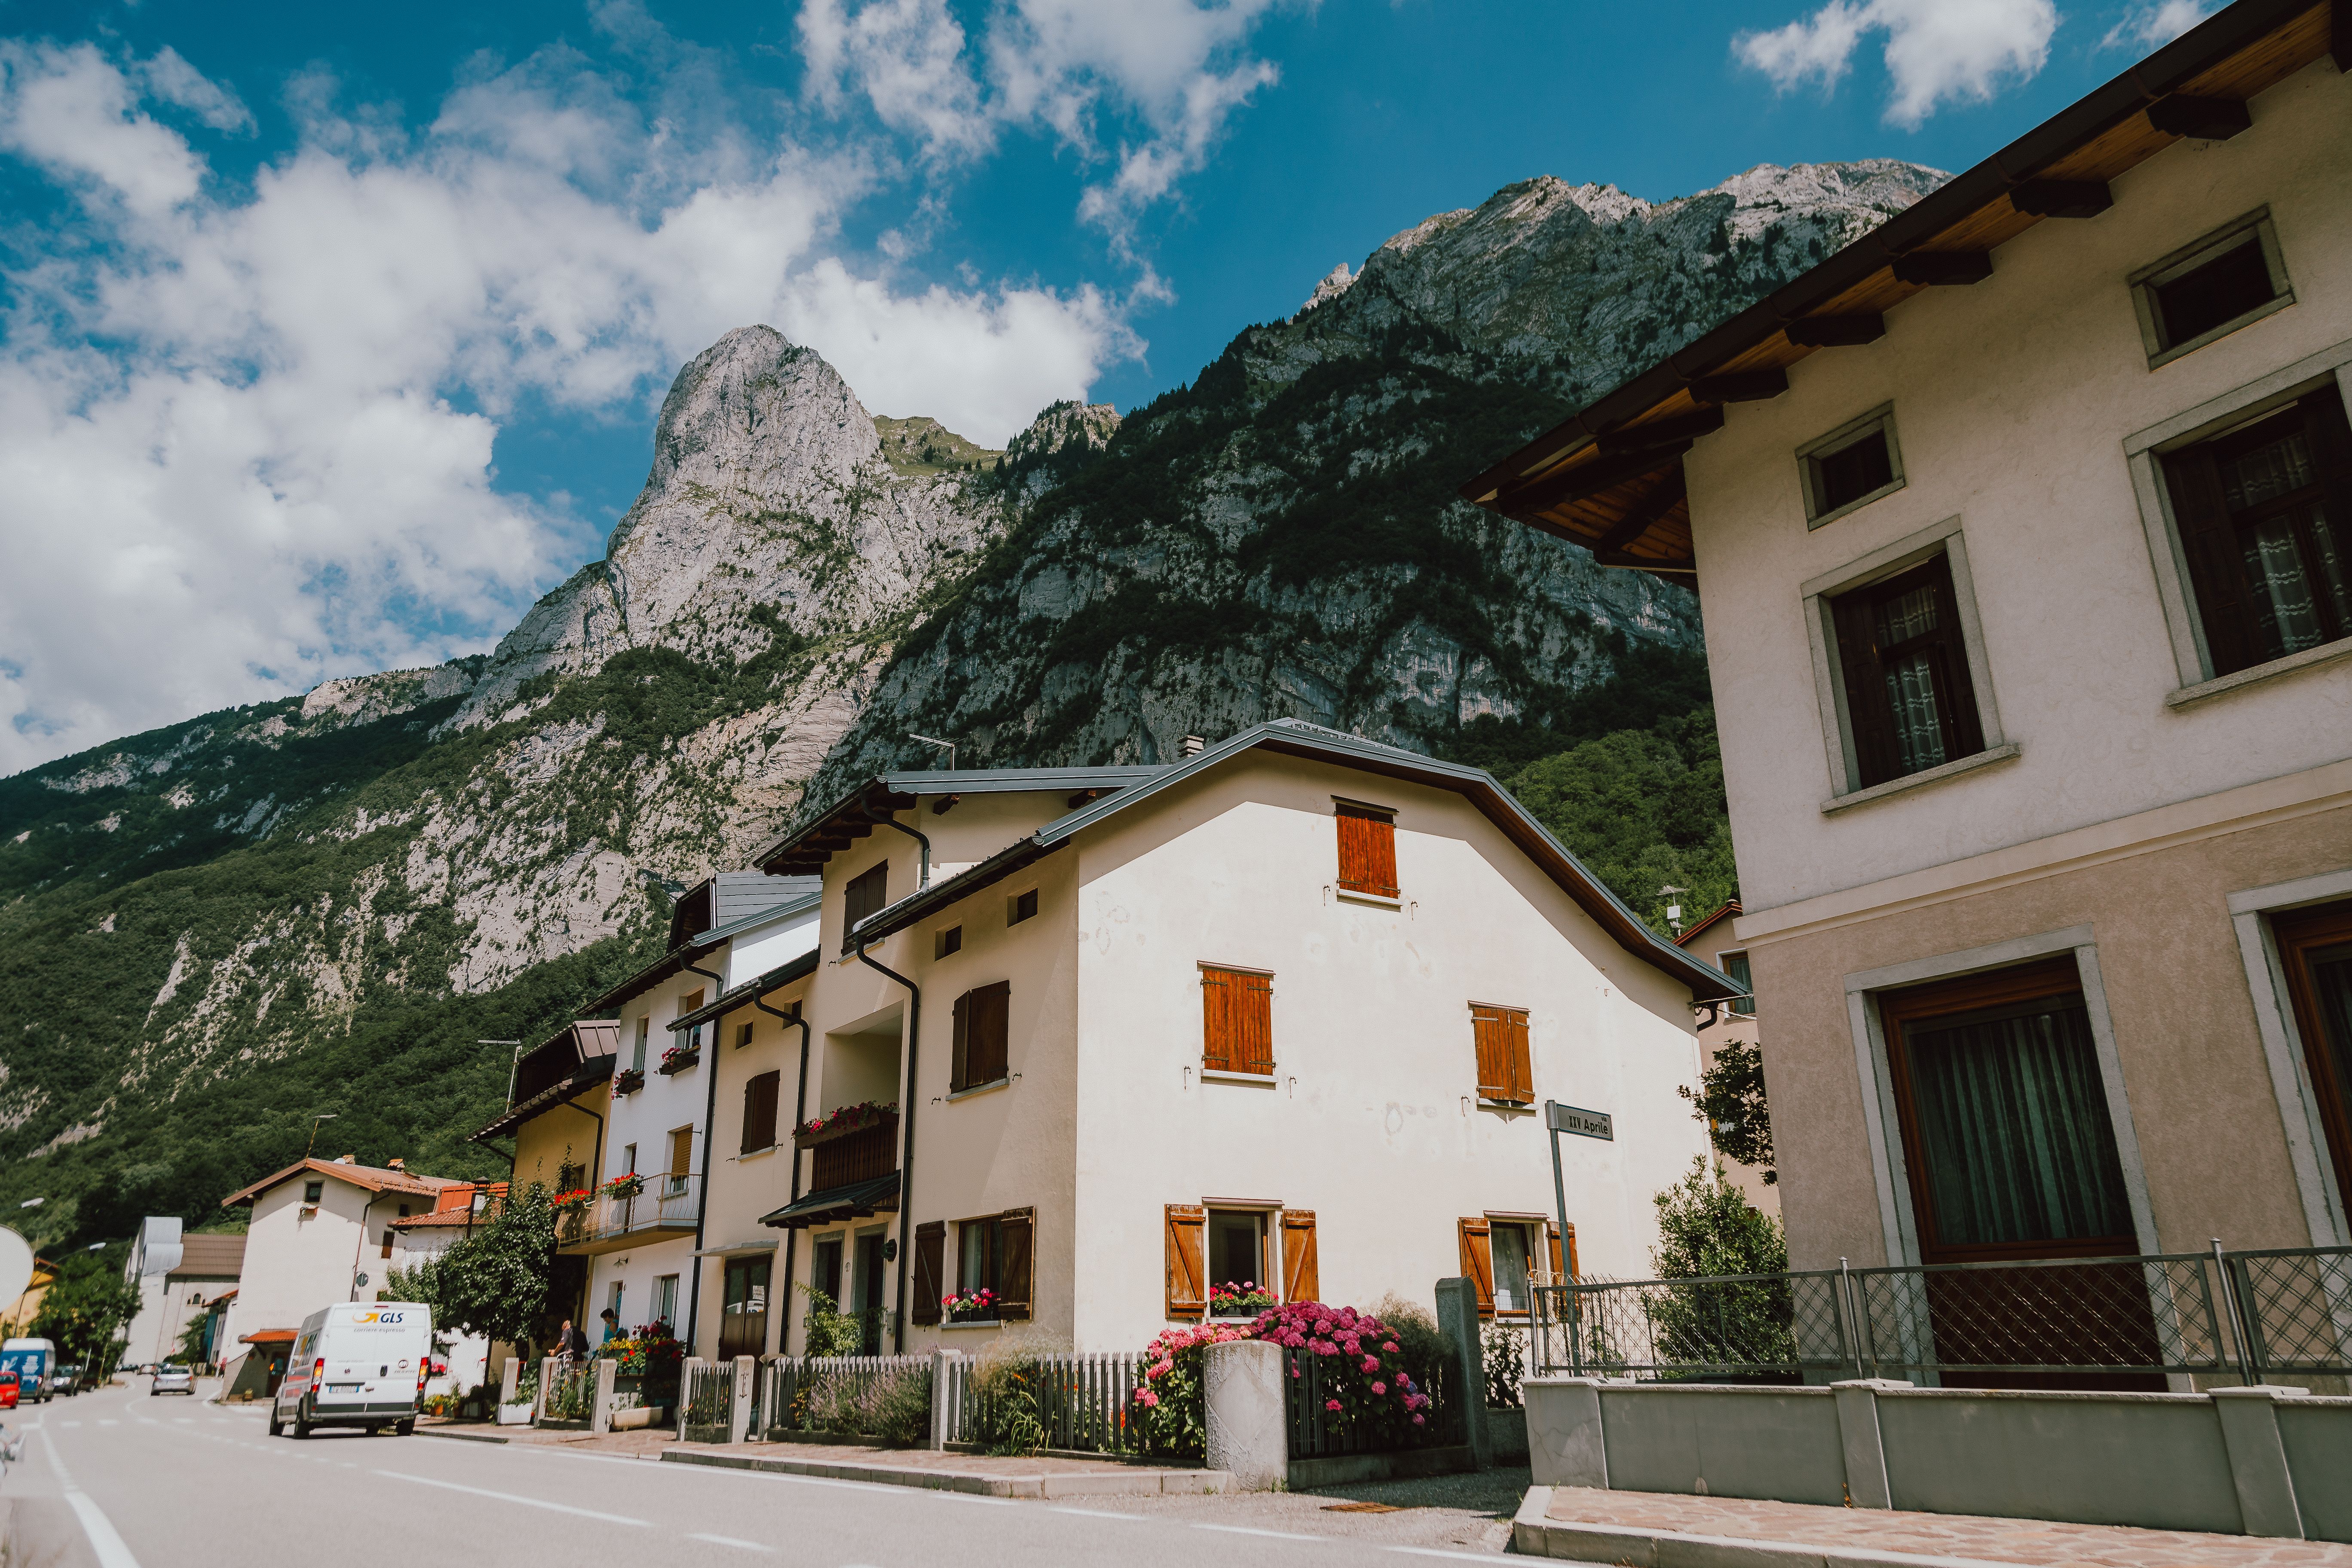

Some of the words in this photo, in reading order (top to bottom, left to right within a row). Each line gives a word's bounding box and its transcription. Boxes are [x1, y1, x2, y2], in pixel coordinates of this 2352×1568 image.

[1568, 1115, 1581, 1130] XXV
[1584, 1118, 1608, 1135] Aprile
[380, 1312, 404, 1323] GLS
